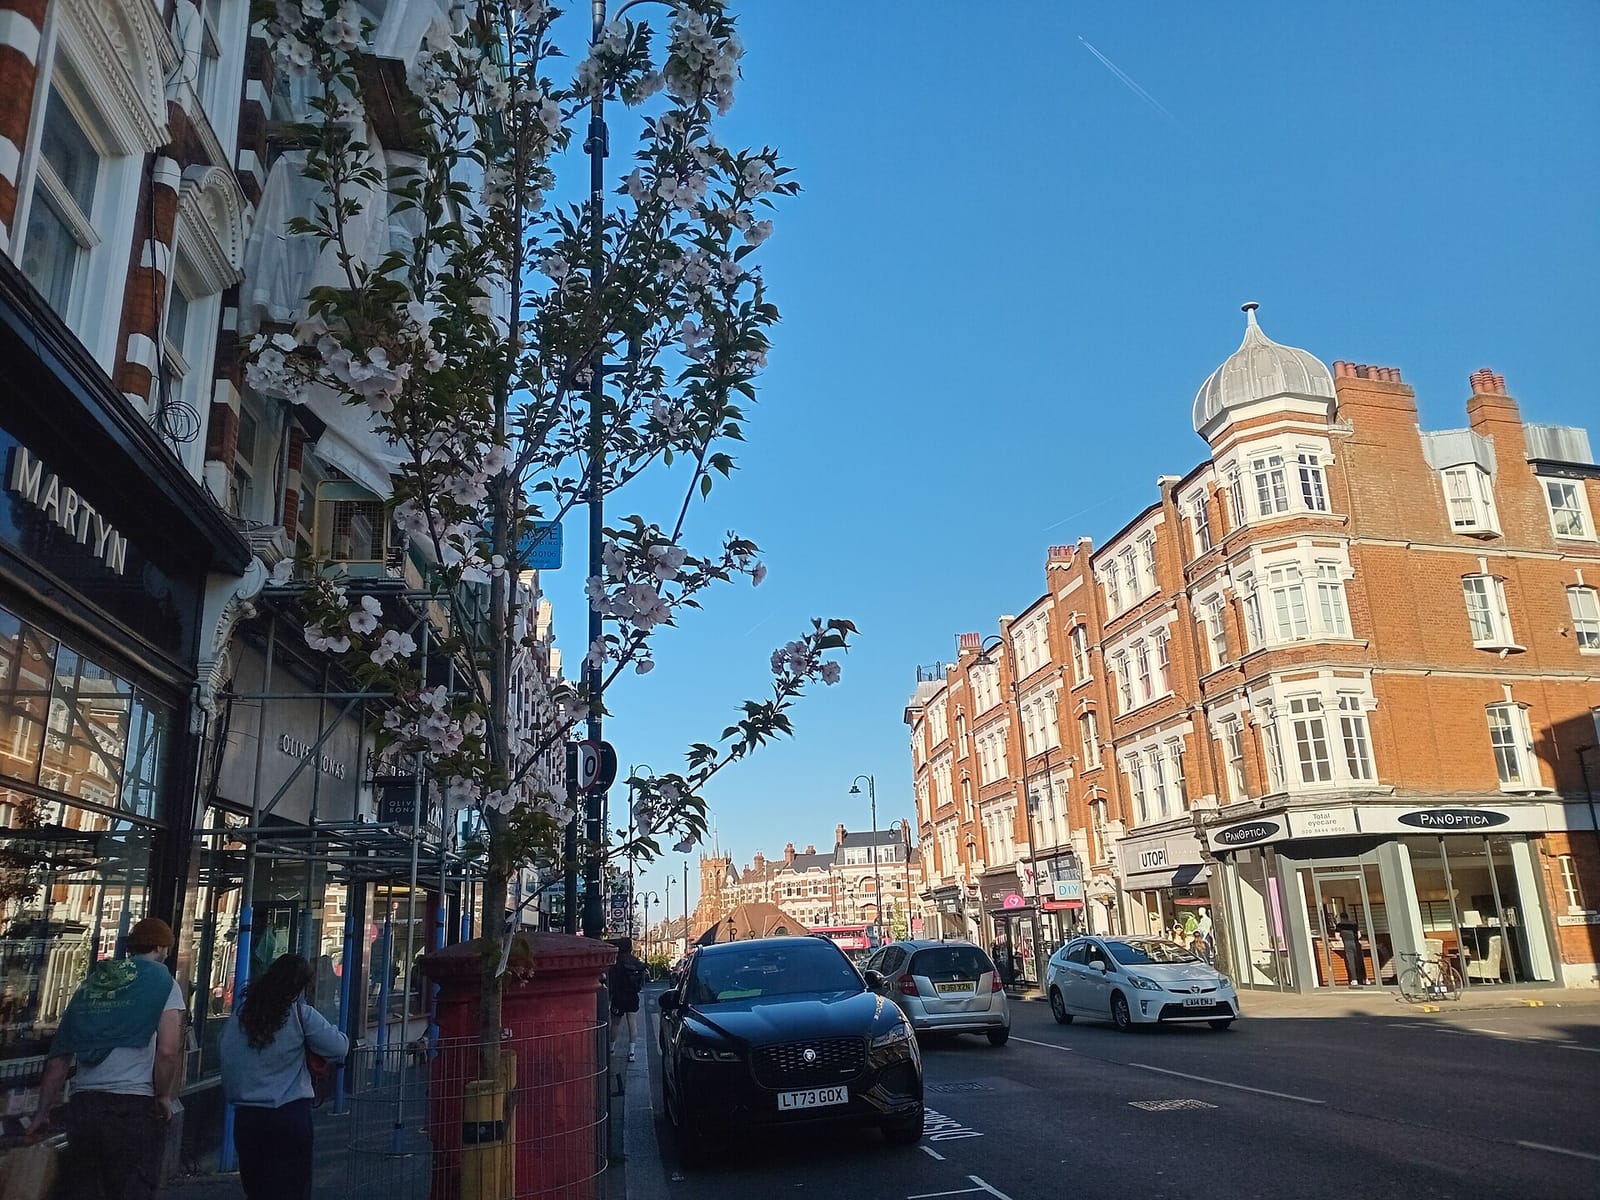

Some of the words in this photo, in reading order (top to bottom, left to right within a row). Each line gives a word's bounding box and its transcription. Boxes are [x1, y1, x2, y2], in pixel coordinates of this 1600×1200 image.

[10, 446, 128, 576] MARTYN
[322, 755, 346, 780] ONAS
[584, 755, 597, 778] 0
[1307, 819, 1336, 828] eyecare
[1141, 850, 1167, 867] UTOPI
[1058, 885, 1078, 896] DIY
[782, 1091, 816, 1107] LT73
[818, 1088, 843, 1103] GOX
